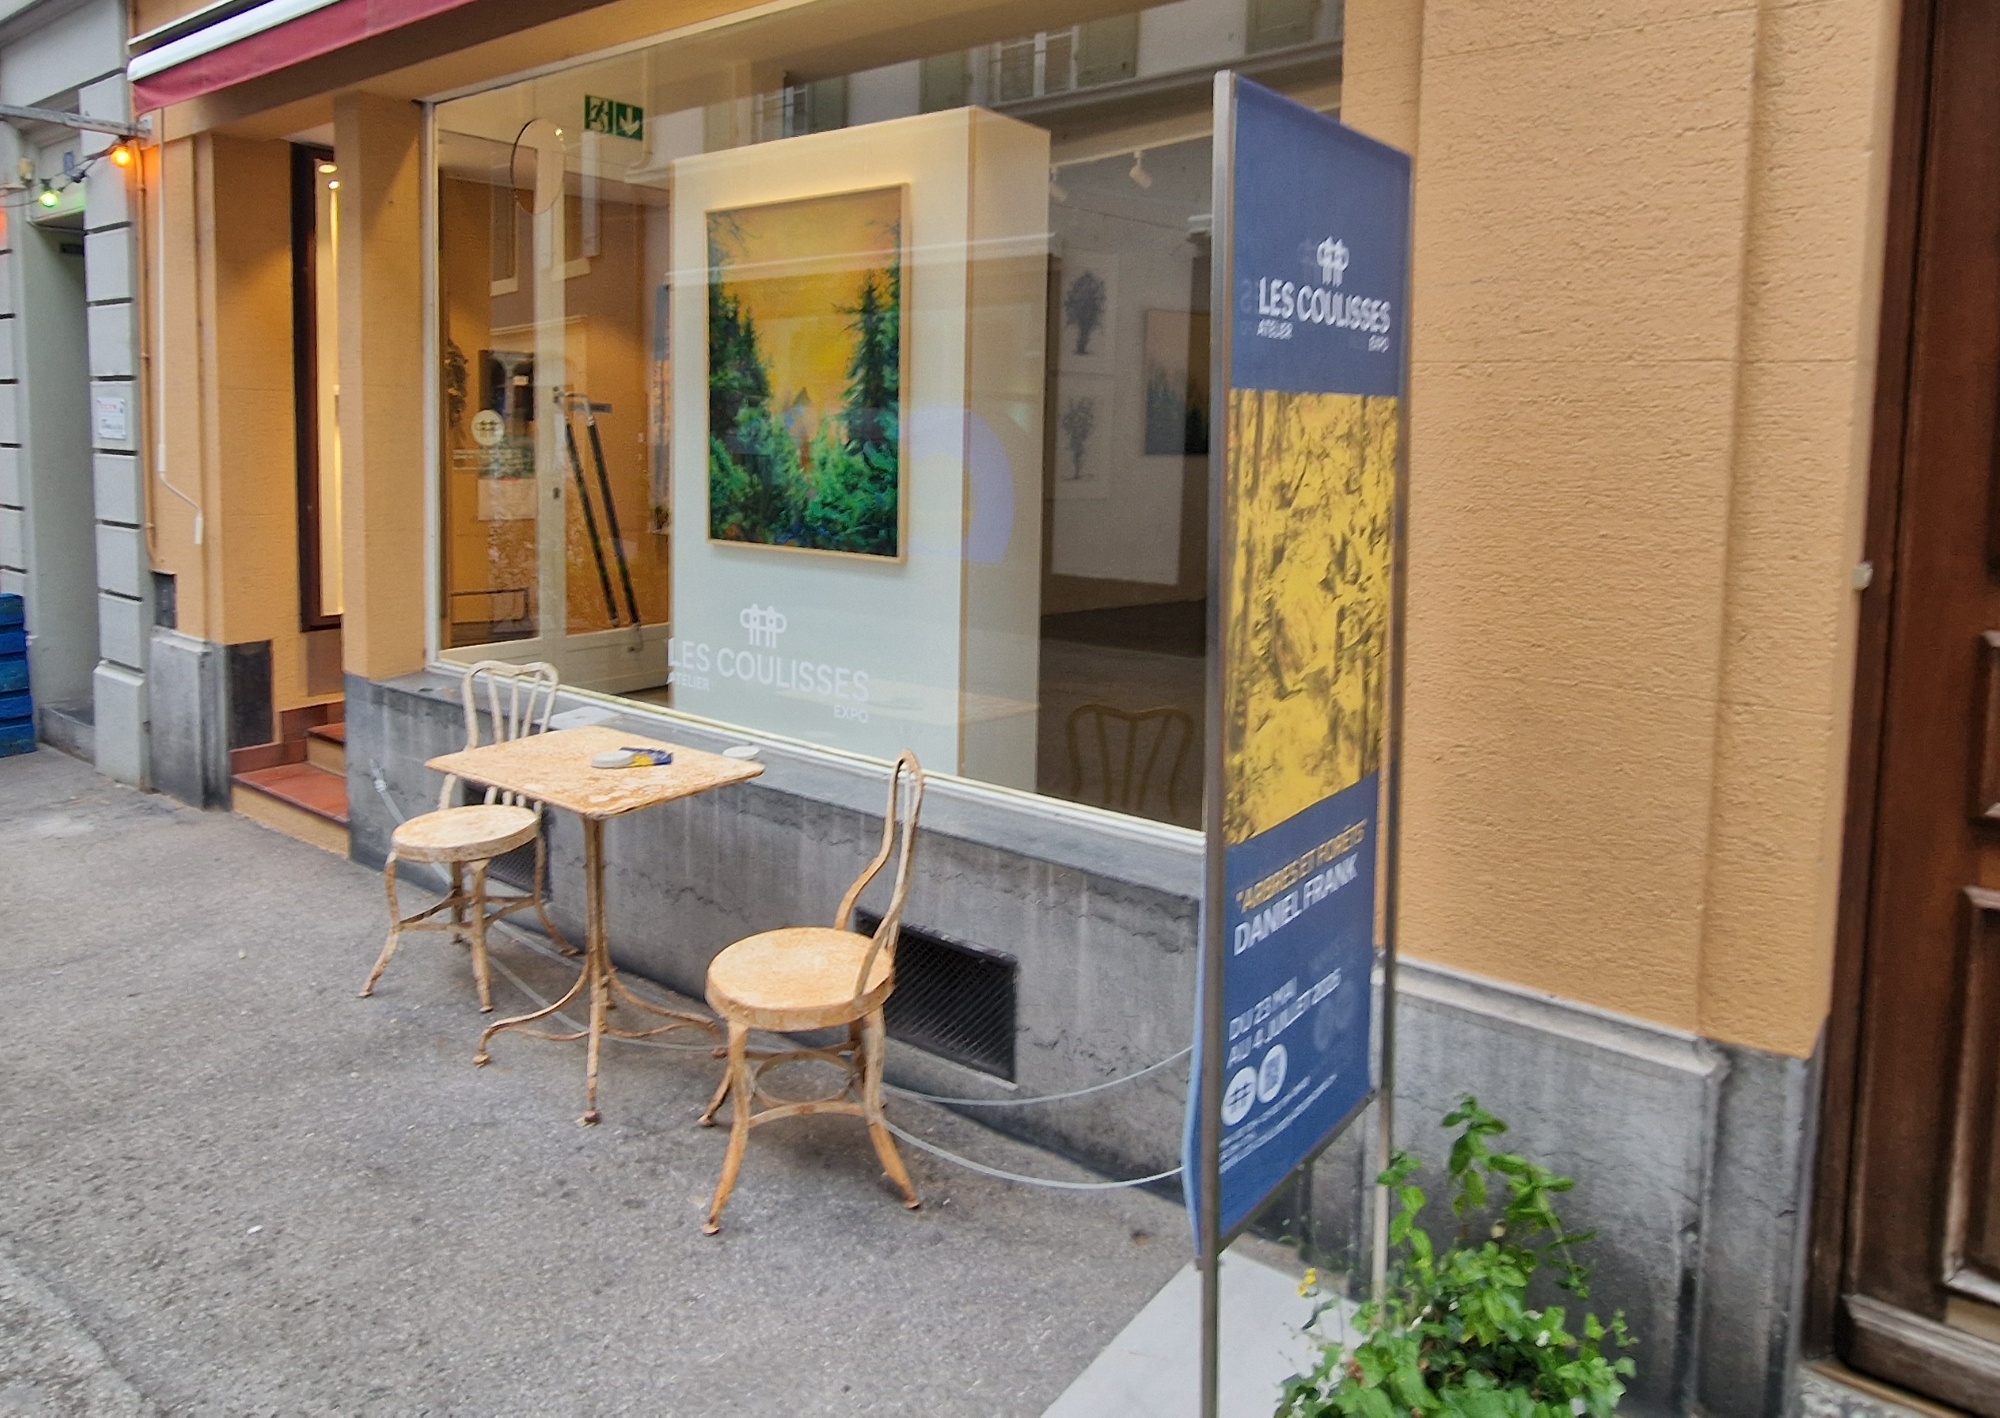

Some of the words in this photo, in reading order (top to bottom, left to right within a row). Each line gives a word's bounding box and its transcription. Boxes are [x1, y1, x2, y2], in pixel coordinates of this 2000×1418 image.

[1258, 276, 1295, 319] LES
[1297, 285, 1391, 334] COULISSES
[666, 672, 710, 691] ATELIER
[667, 637, 710, 672] LES
[717, 648, 870, 702] COULISSES
[834, 705, 868, 723] EXPO
[1234, 890, 1302, 956] DANIEL
[1303, 852, 1359, 911] FRANK
